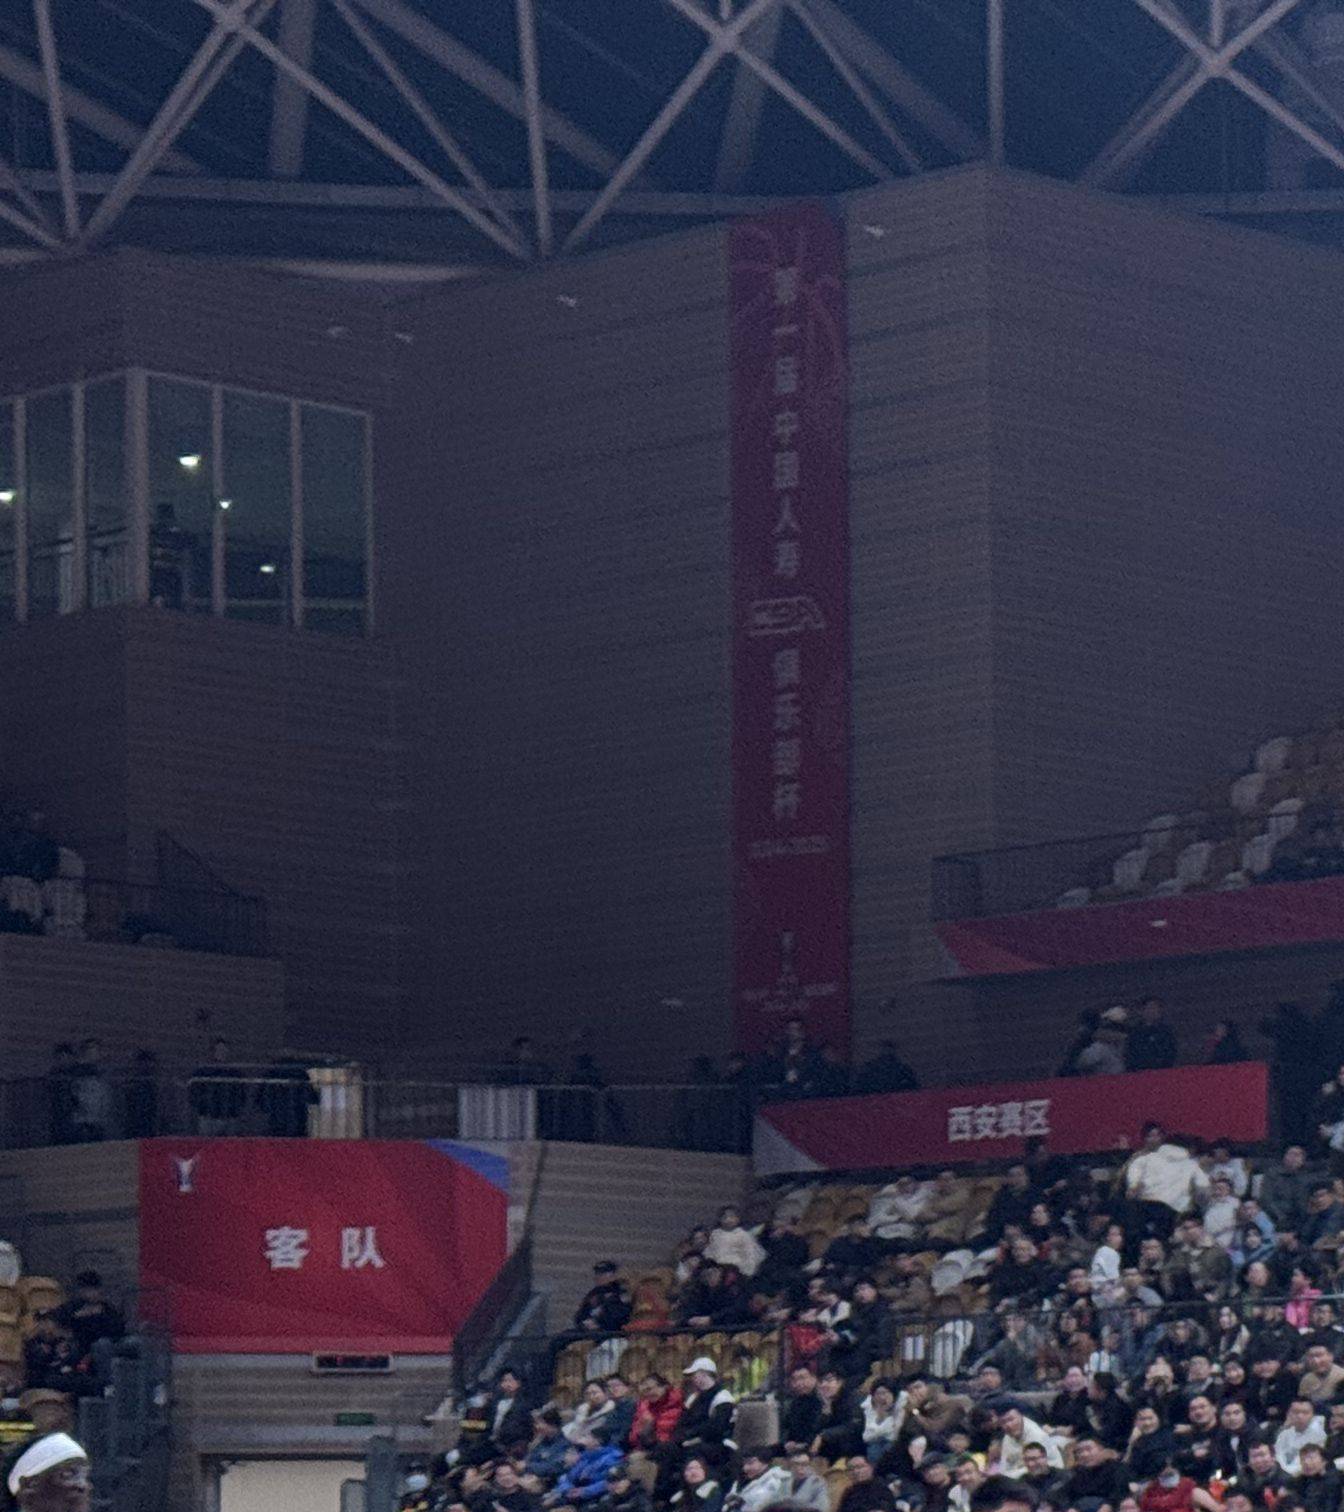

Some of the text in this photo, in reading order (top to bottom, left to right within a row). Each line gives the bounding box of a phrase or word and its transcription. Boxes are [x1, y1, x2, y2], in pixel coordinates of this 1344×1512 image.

[947, 1099, 1052, 1143] 西安赛区
[264, 1225, 388, 1270] 客队
